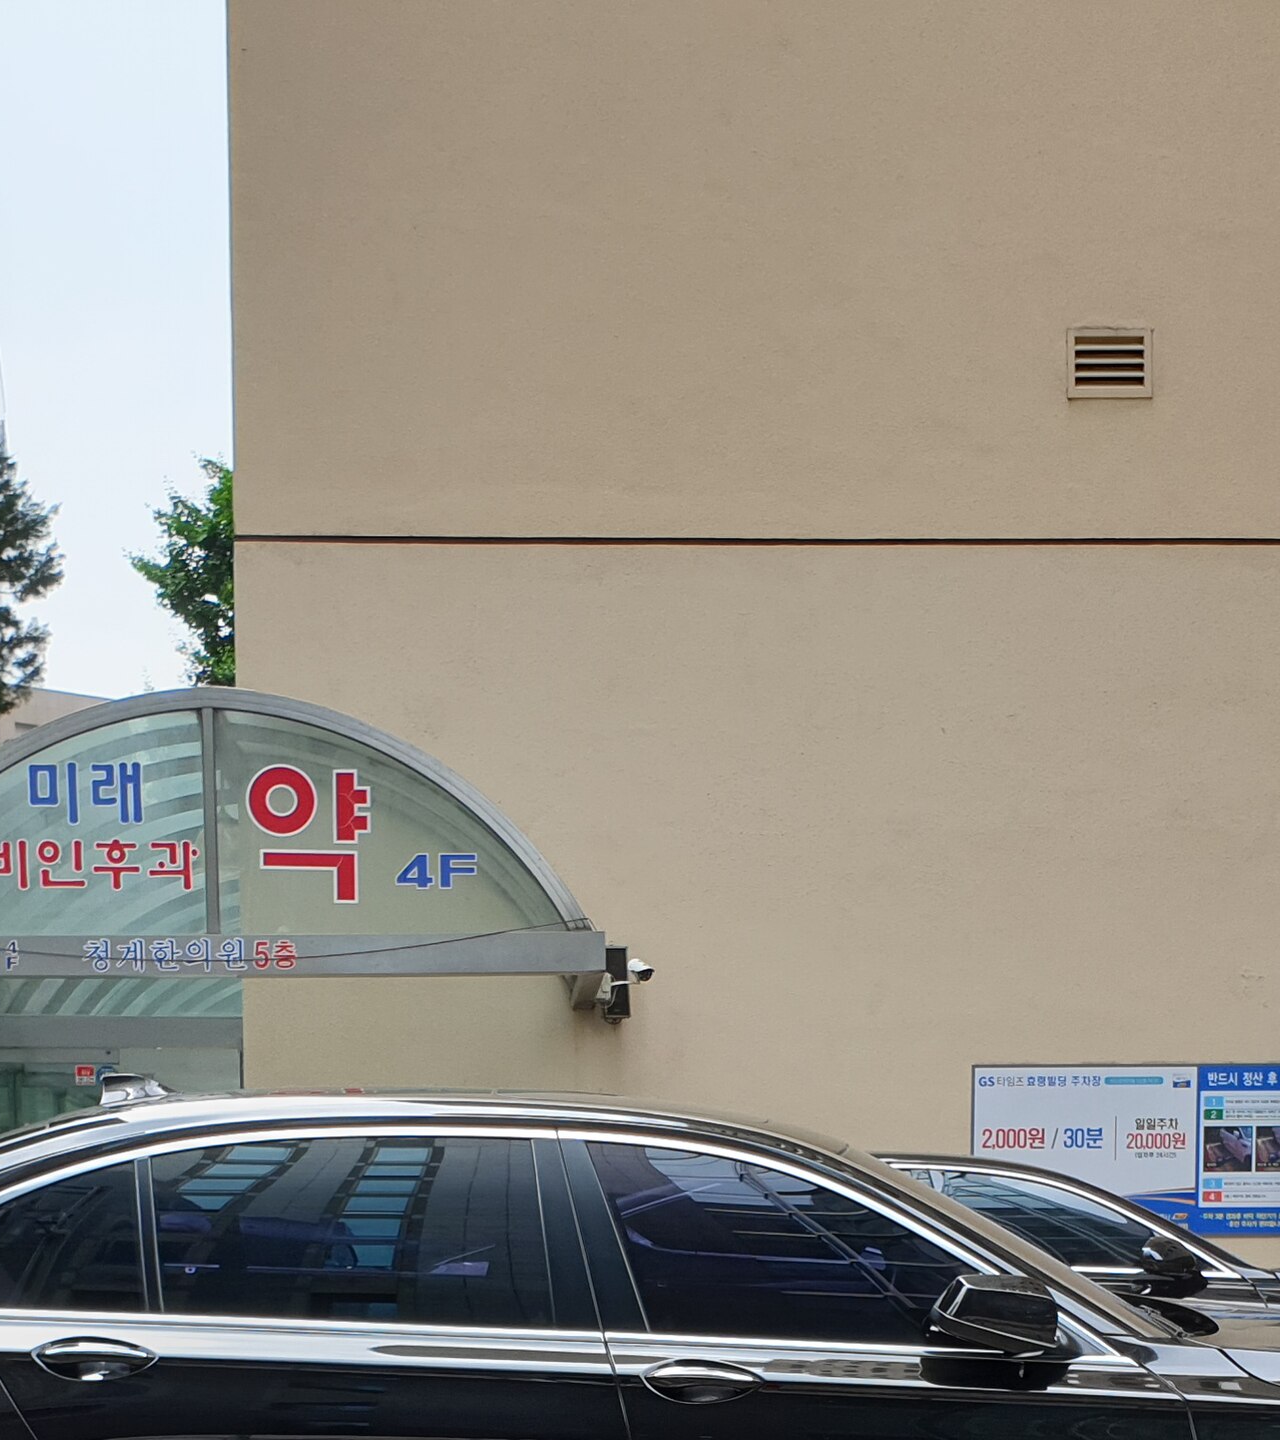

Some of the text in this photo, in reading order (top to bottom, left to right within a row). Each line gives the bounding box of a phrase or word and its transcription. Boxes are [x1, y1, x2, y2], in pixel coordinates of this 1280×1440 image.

[26, 760, 144, 825] 미래
[246, 763, 372, 904] 약
[395, 852, 478, 890] 4F
[82, 938, 248, 973] 청계한의원
[1071, 1075, 1101, 1088] 주차장
[1207, 1071, 1238, 1087] 반드시
[1242, 1072, 1264, 1087] 정산
[1267, 1071, 1278, 1087] 후
[1134, 1117, 1179, 1131] 일일주차
[981, 1127, 1046, 1150] 2,000원
[1063, 1127, 1104, 1150] 30분
[1126, 1132, 1187, 1150] 20,000원
